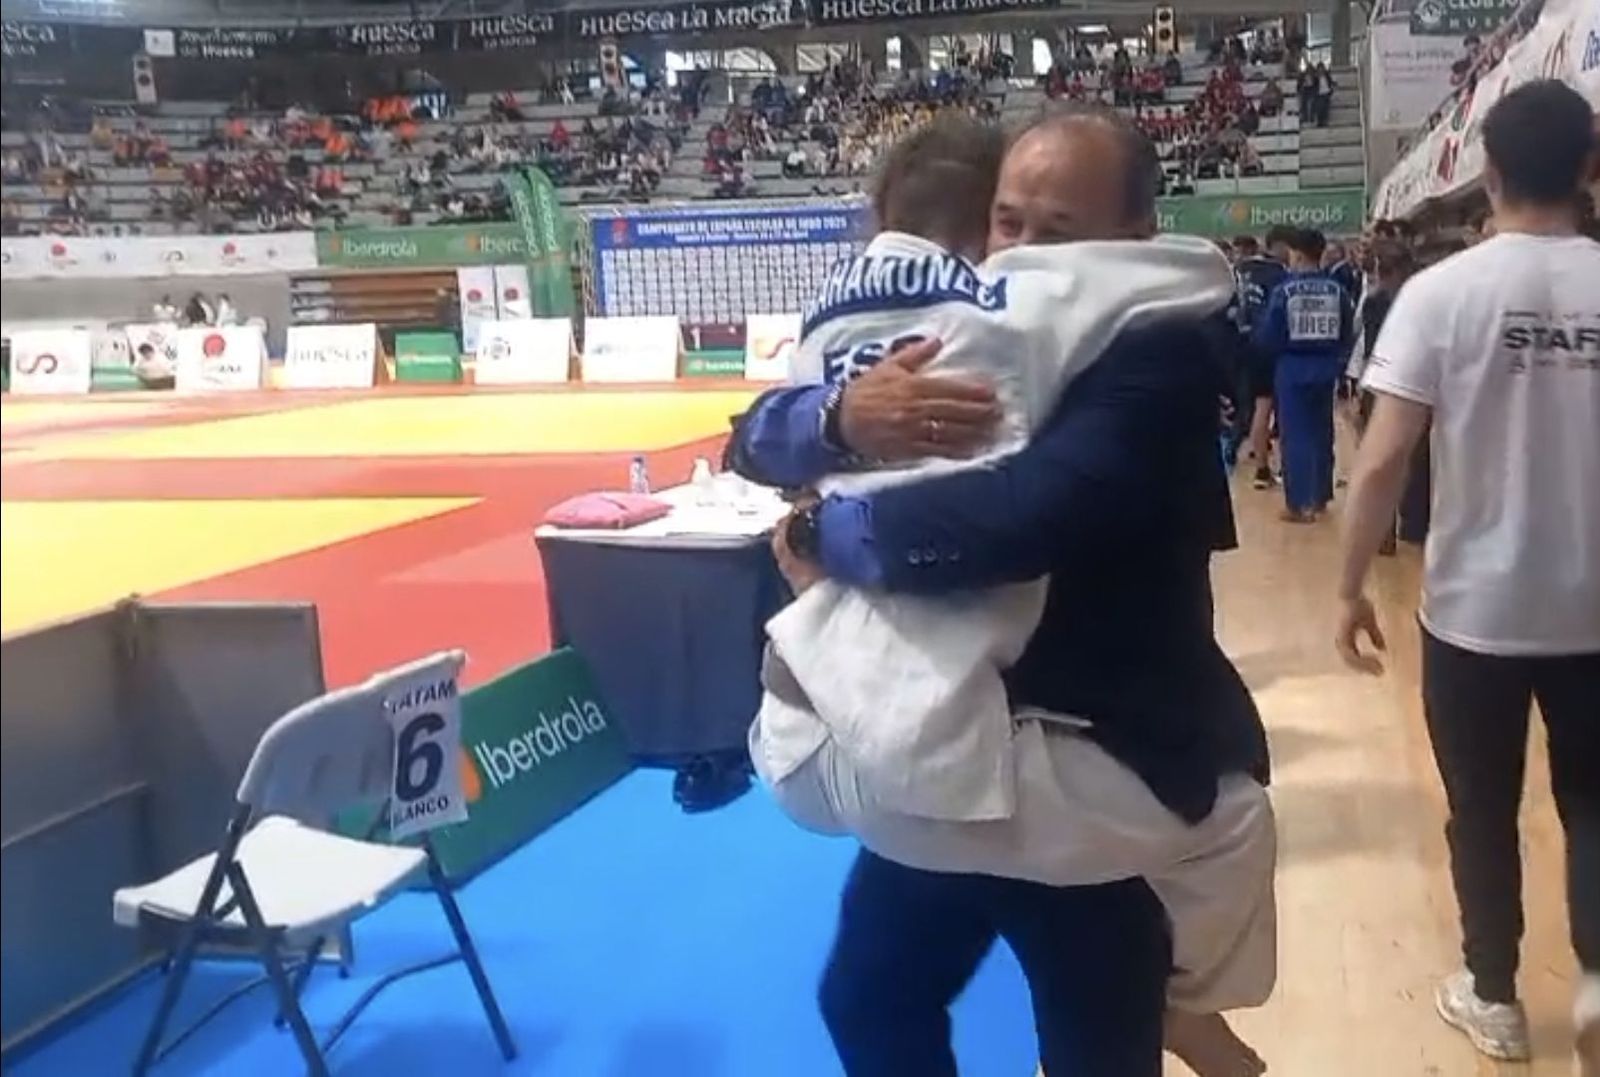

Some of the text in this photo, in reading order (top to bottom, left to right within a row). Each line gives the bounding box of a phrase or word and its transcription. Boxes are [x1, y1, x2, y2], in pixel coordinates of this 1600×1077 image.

[1251, 204, 1344, 226] Iberdrola
[343, 238, 417, 258] Iberdrola
[395, 713, 446, 801] 6
[475, 697, 607, 789] Iberdrola
